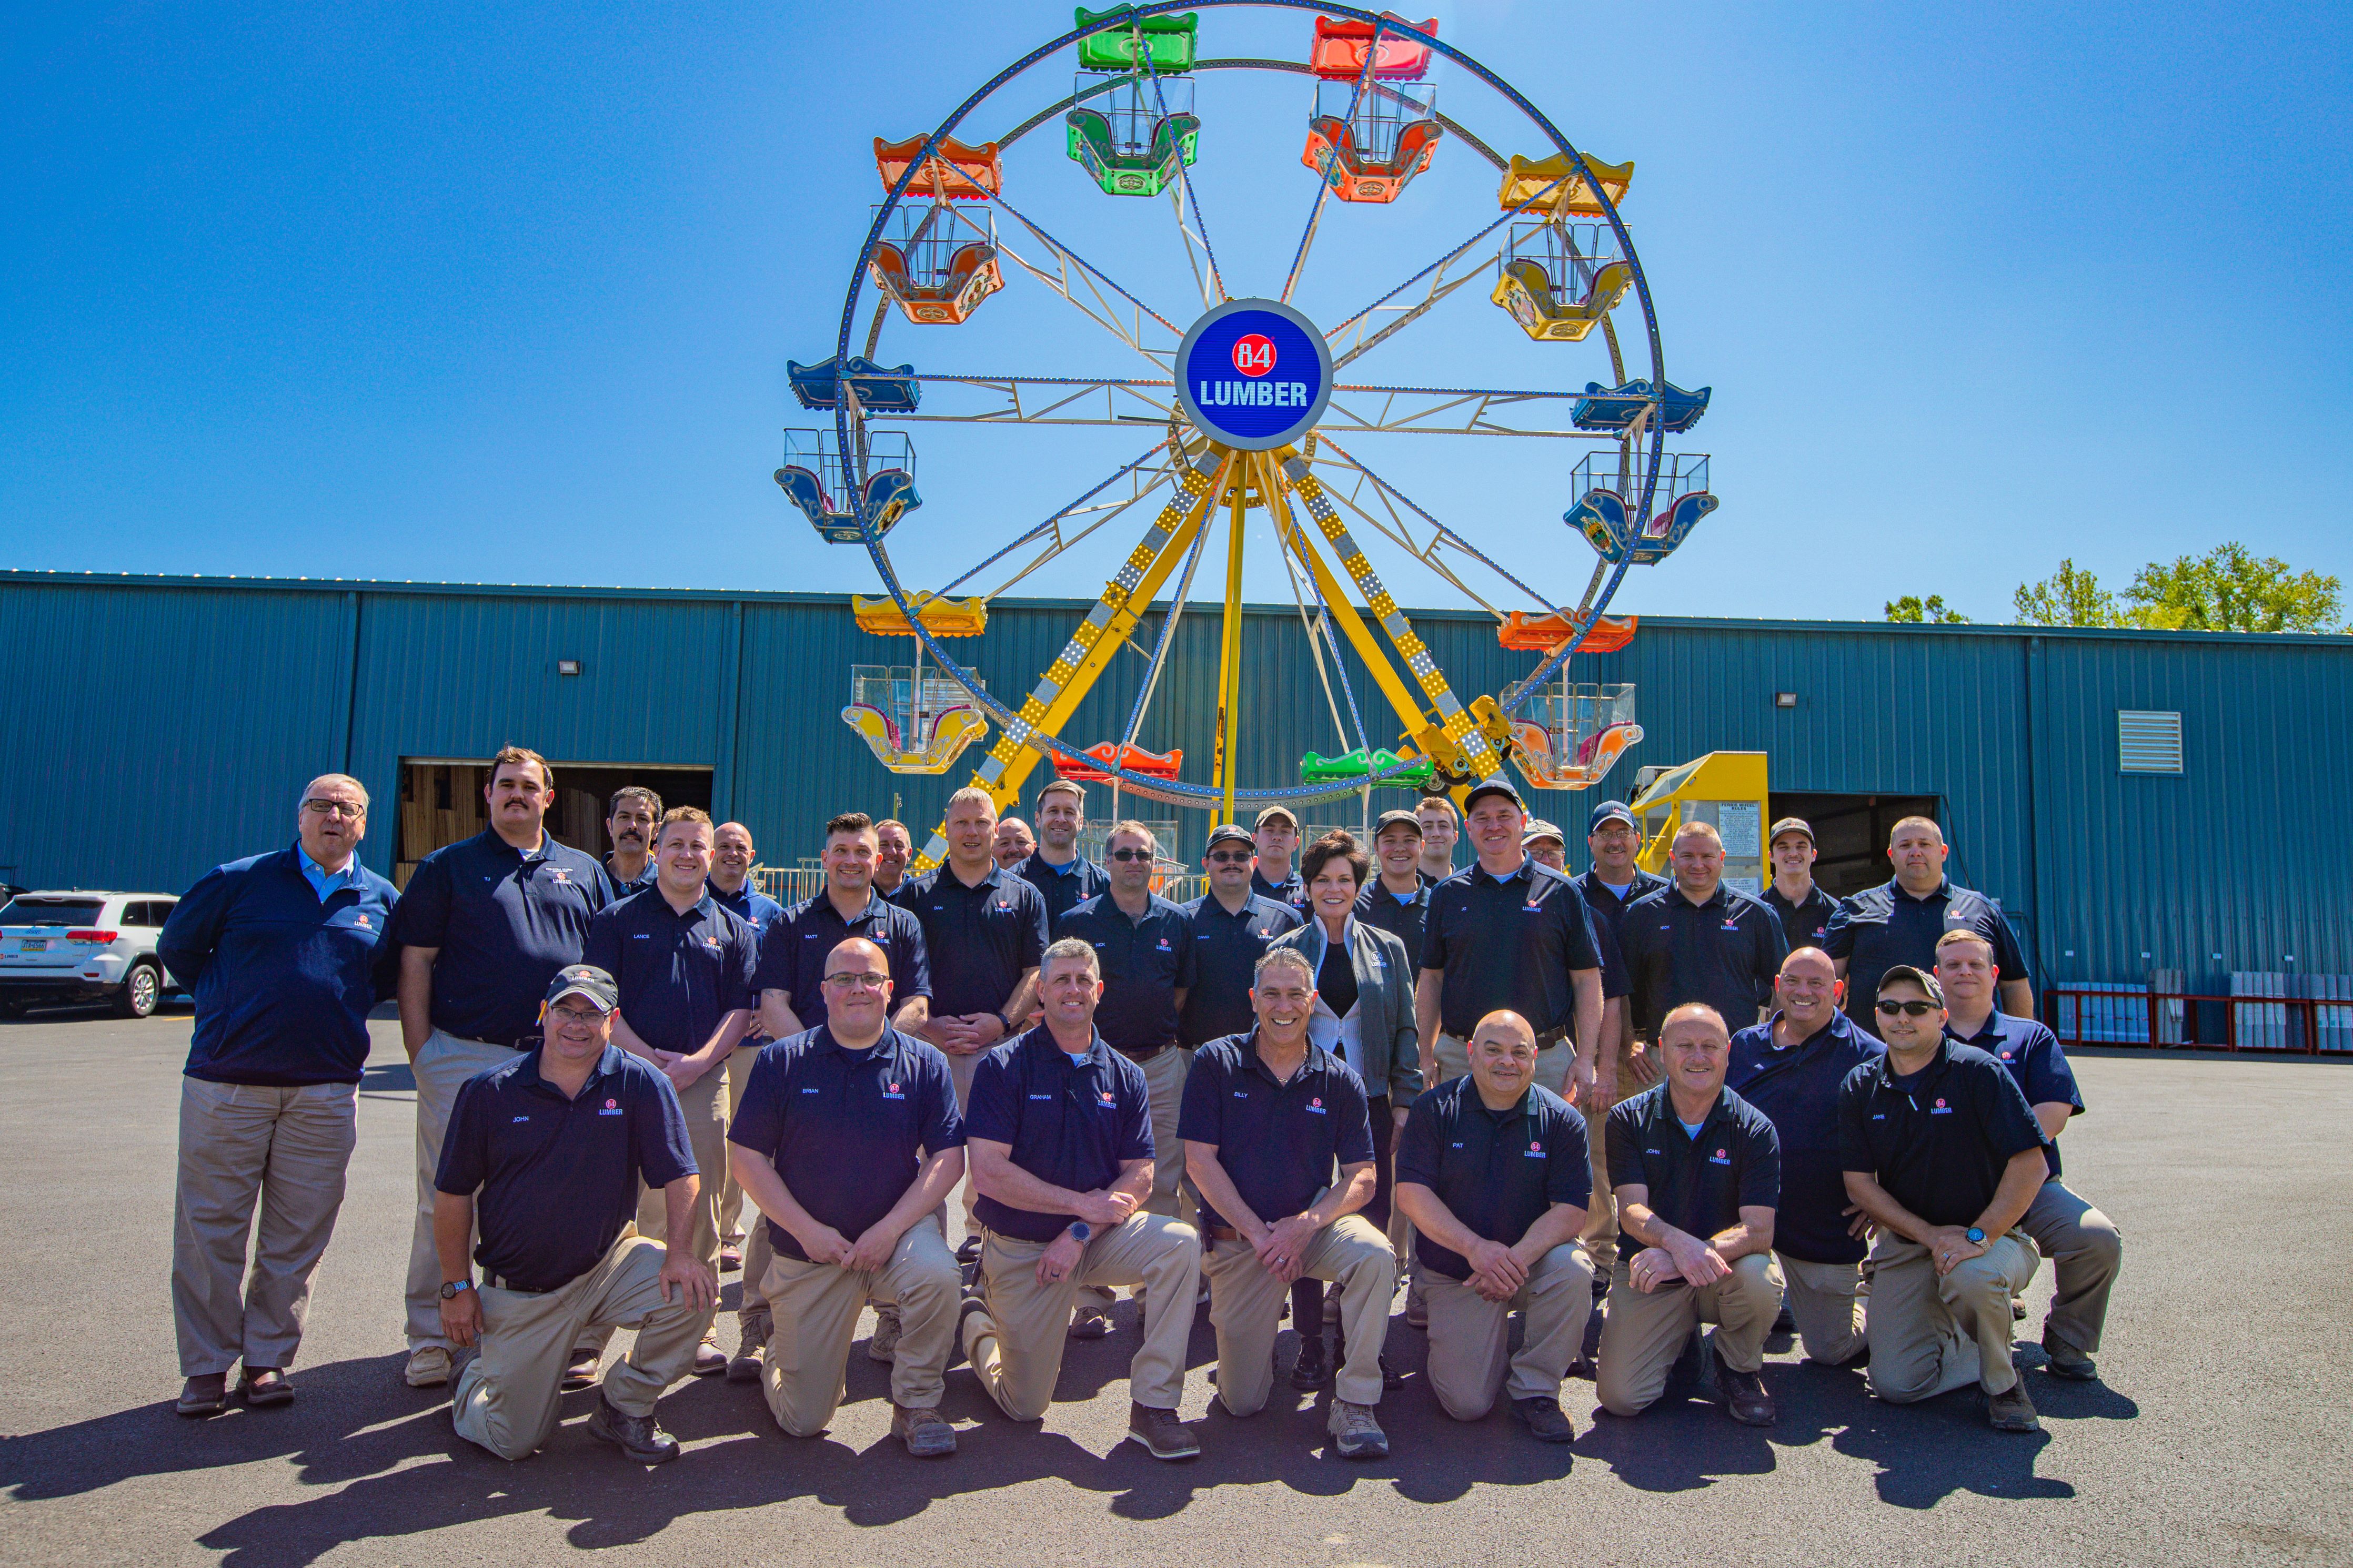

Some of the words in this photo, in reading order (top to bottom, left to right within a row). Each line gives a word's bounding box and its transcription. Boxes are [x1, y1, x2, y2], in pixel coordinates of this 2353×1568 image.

[1238, 343, 1271, 368] 84
[1200, 381, 1307, 406] LUMBER
[354, 920, 373, 929] LUMBER
[702, 942, 721, 950] LUMBER
[1098, 1100, 1116, 1109] LUMBER
[1306, 1105, 1326, 1114] LUMBER
[1710, 1156, 1730, 1165] LUMBER
